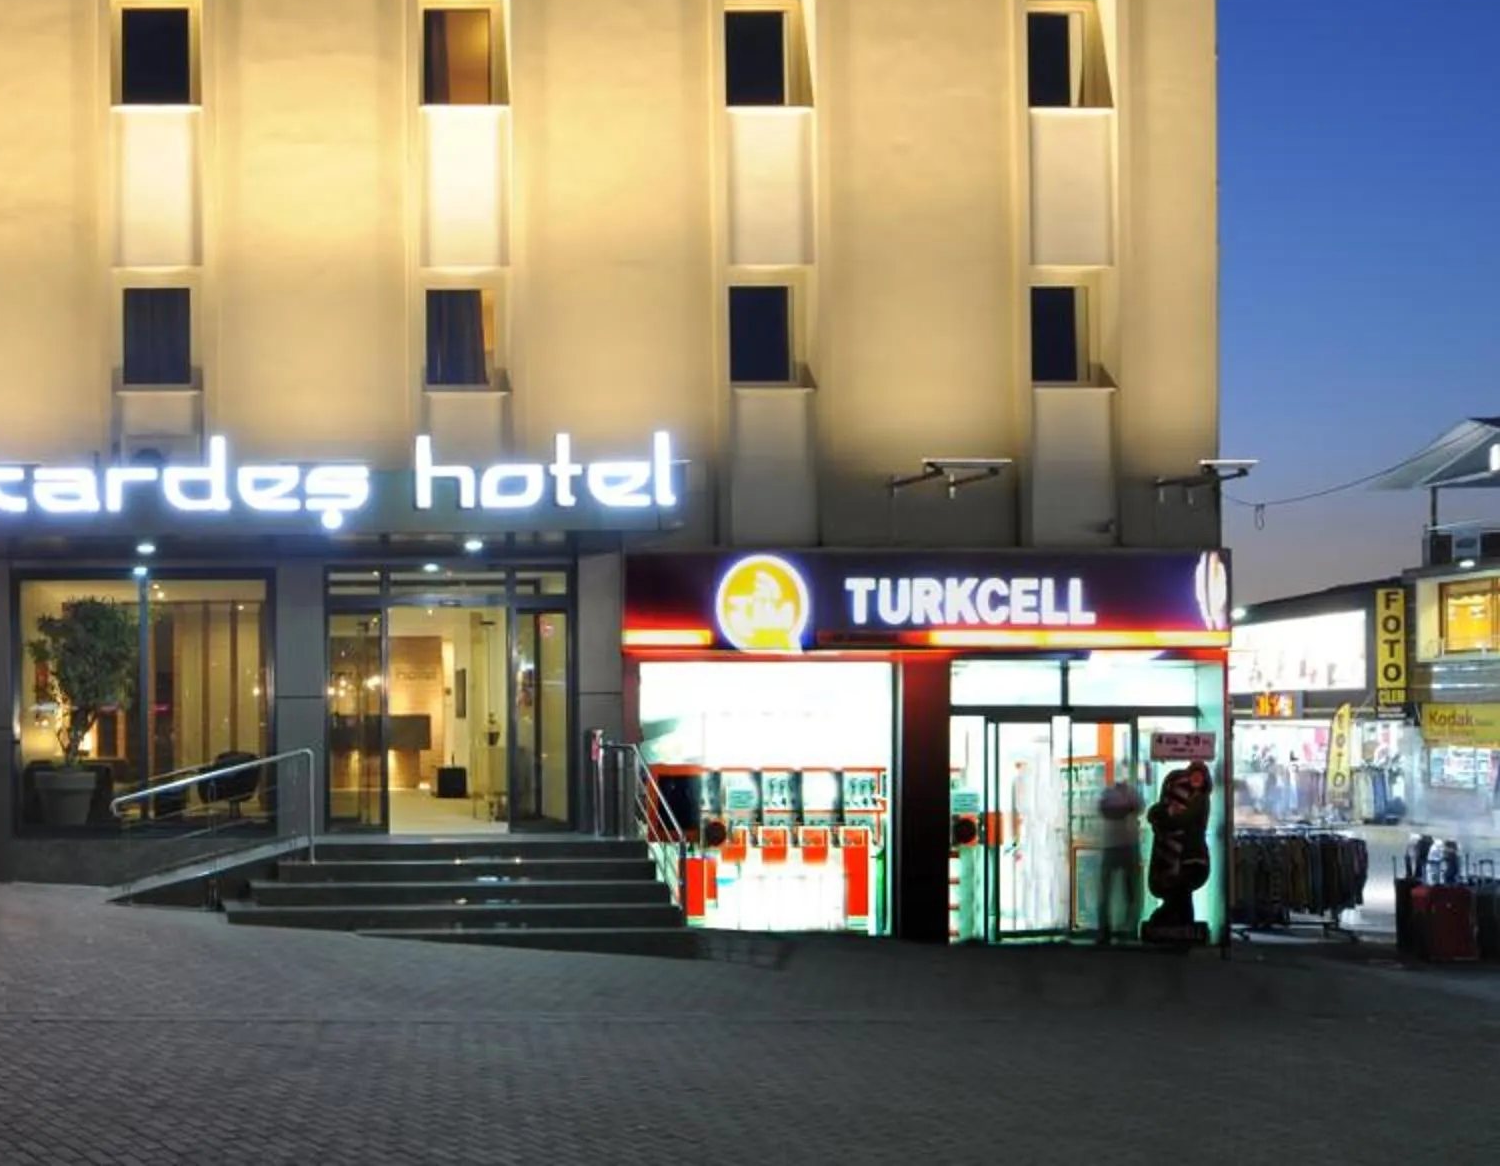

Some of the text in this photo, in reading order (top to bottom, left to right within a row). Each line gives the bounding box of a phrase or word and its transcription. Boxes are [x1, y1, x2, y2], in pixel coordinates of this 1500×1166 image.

[415, 430, 677, 510] hotel
[845, 577, 1096, 625] TURKCELL
[1381, 591, 1402, 683] FOTO
